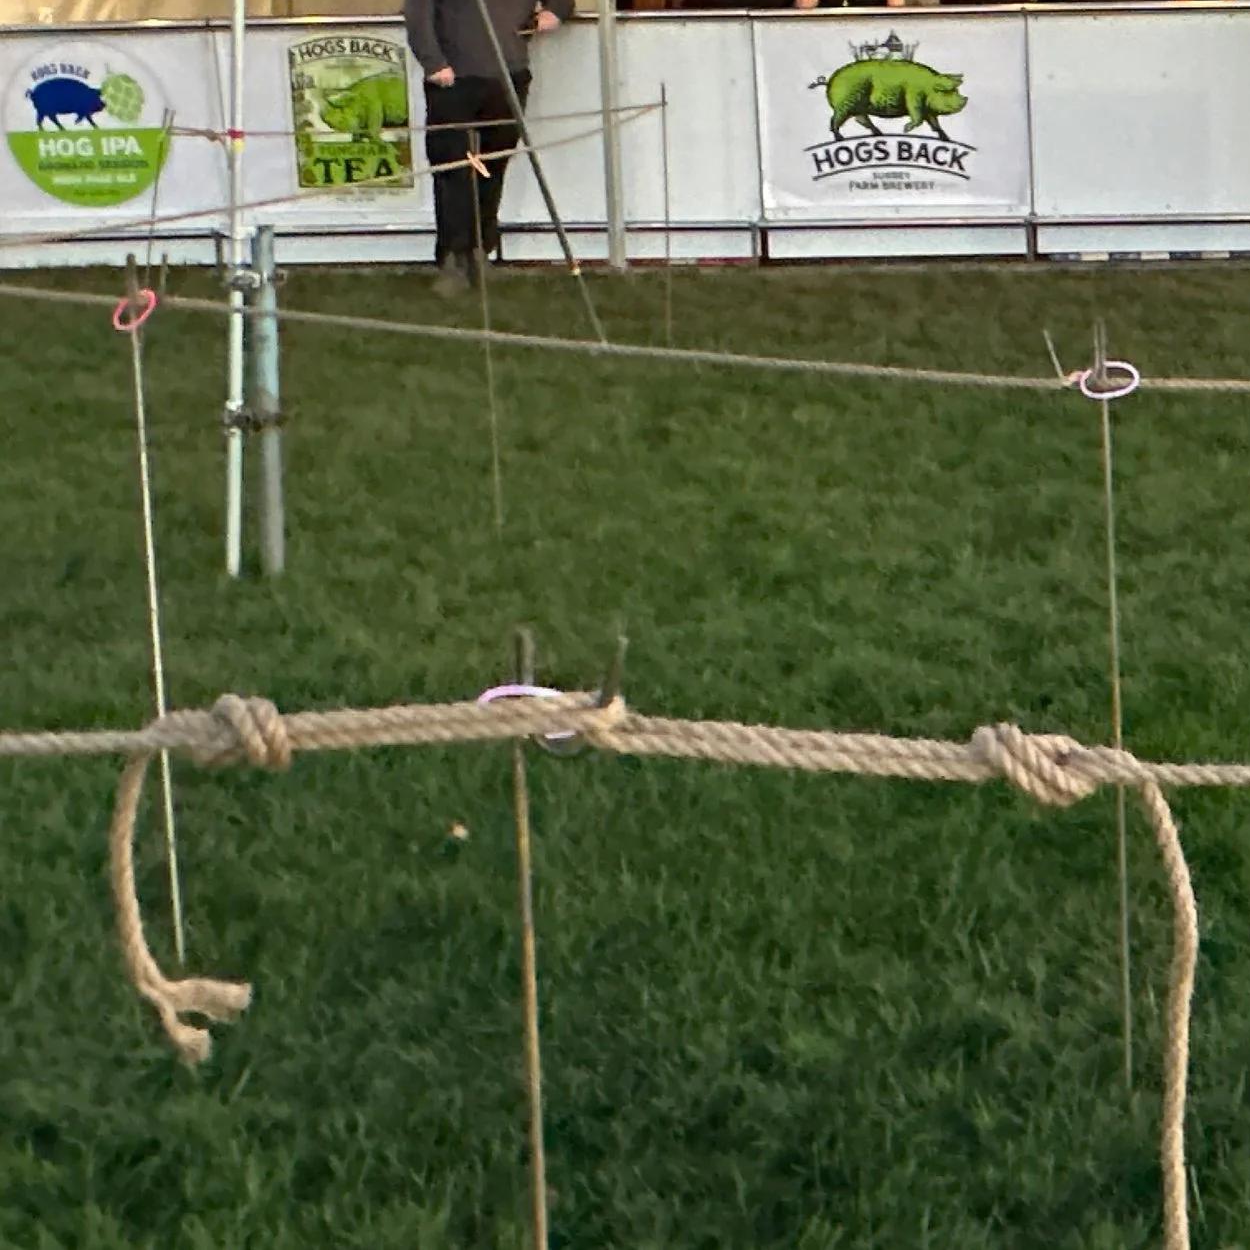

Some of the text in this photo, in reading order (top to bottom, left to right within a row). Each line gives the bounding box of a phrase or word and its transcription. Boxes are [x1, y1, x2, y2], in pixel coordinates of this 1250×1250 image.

[298, 39, 346, 60] HOGS
[38, 135, 144, 158] HOG IPA
[812, 140, 971, 173] HOGS BACK
[313, 157, 394, 184] TEA
